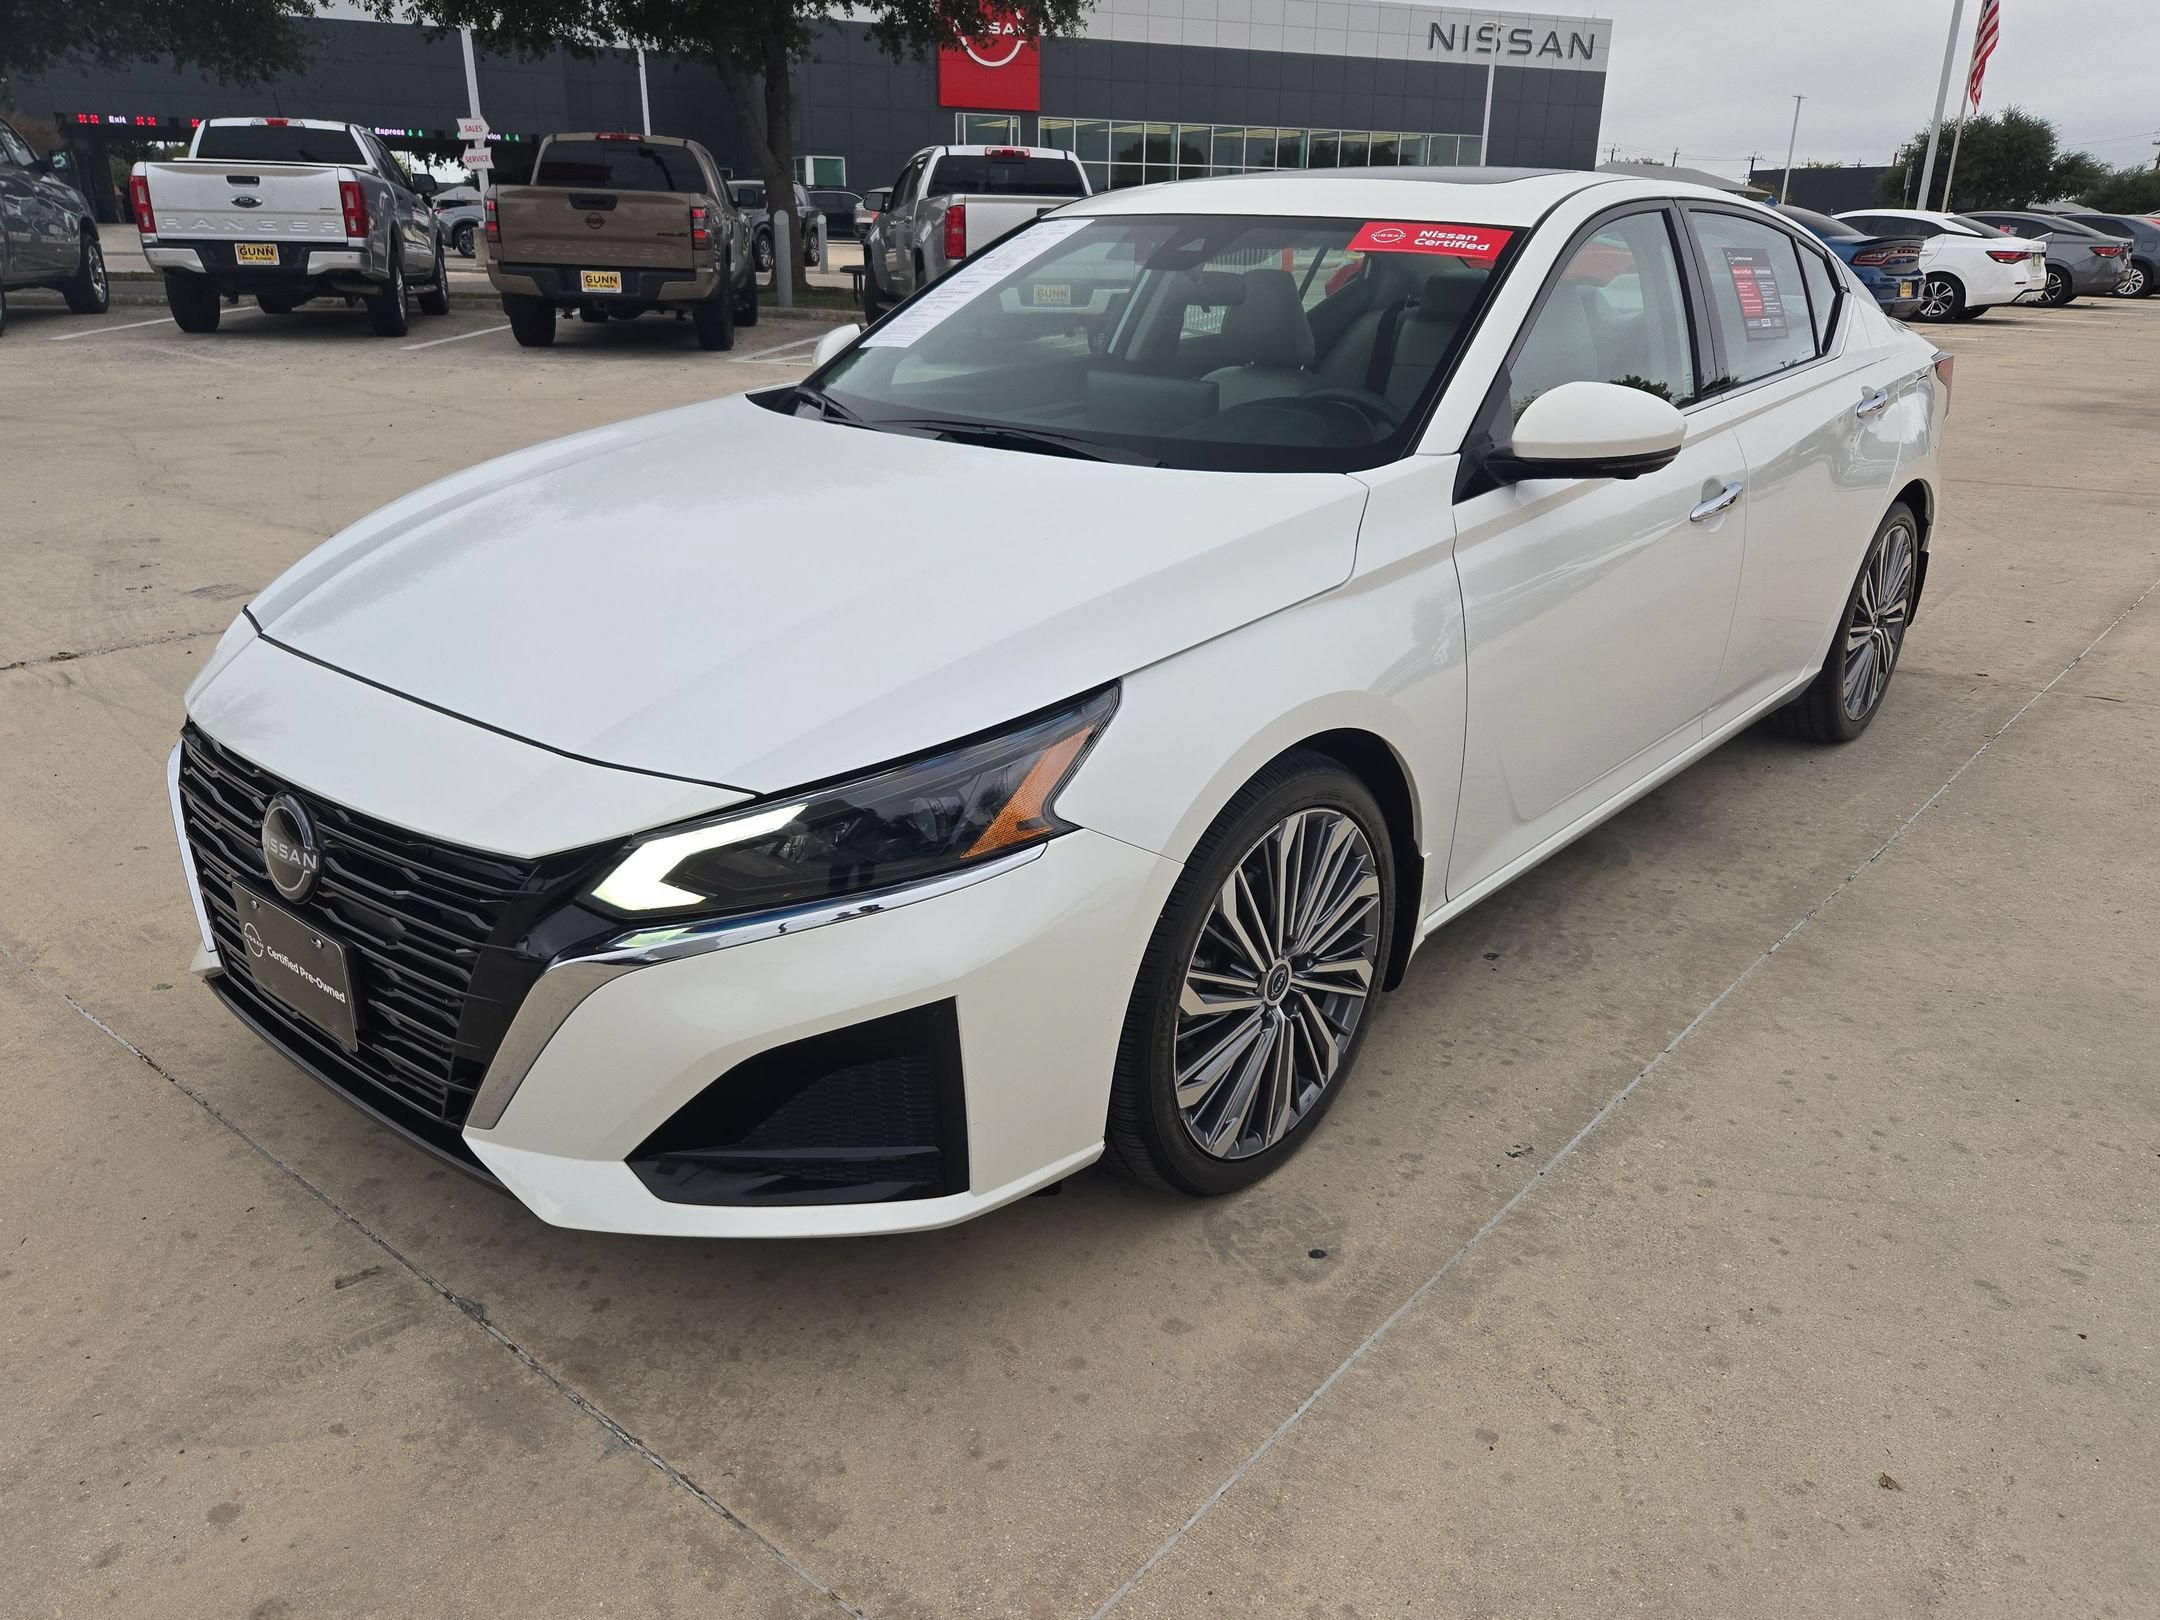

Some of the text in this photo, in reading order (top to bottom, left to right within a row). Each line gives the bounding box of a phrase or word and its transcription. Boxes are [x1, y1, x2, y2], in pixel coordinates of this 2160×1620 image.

[1428, 22, 1595, 60] NISSAN
[108, 115, 126, 124] Exit
[374, 127, 405, 136] Express
[464, 125, 483, 133] SALES
[465, 155, 489, 163] SERVICE
[1419, 230, 1478, 241] Nissan
[1413, 238, 1490, 251] Certified
[240, 247, 274, 257] GUNN
[585, 274, 618, 285] GUNN
[266, 945, 346, 1004] Certified Pre-Owned
